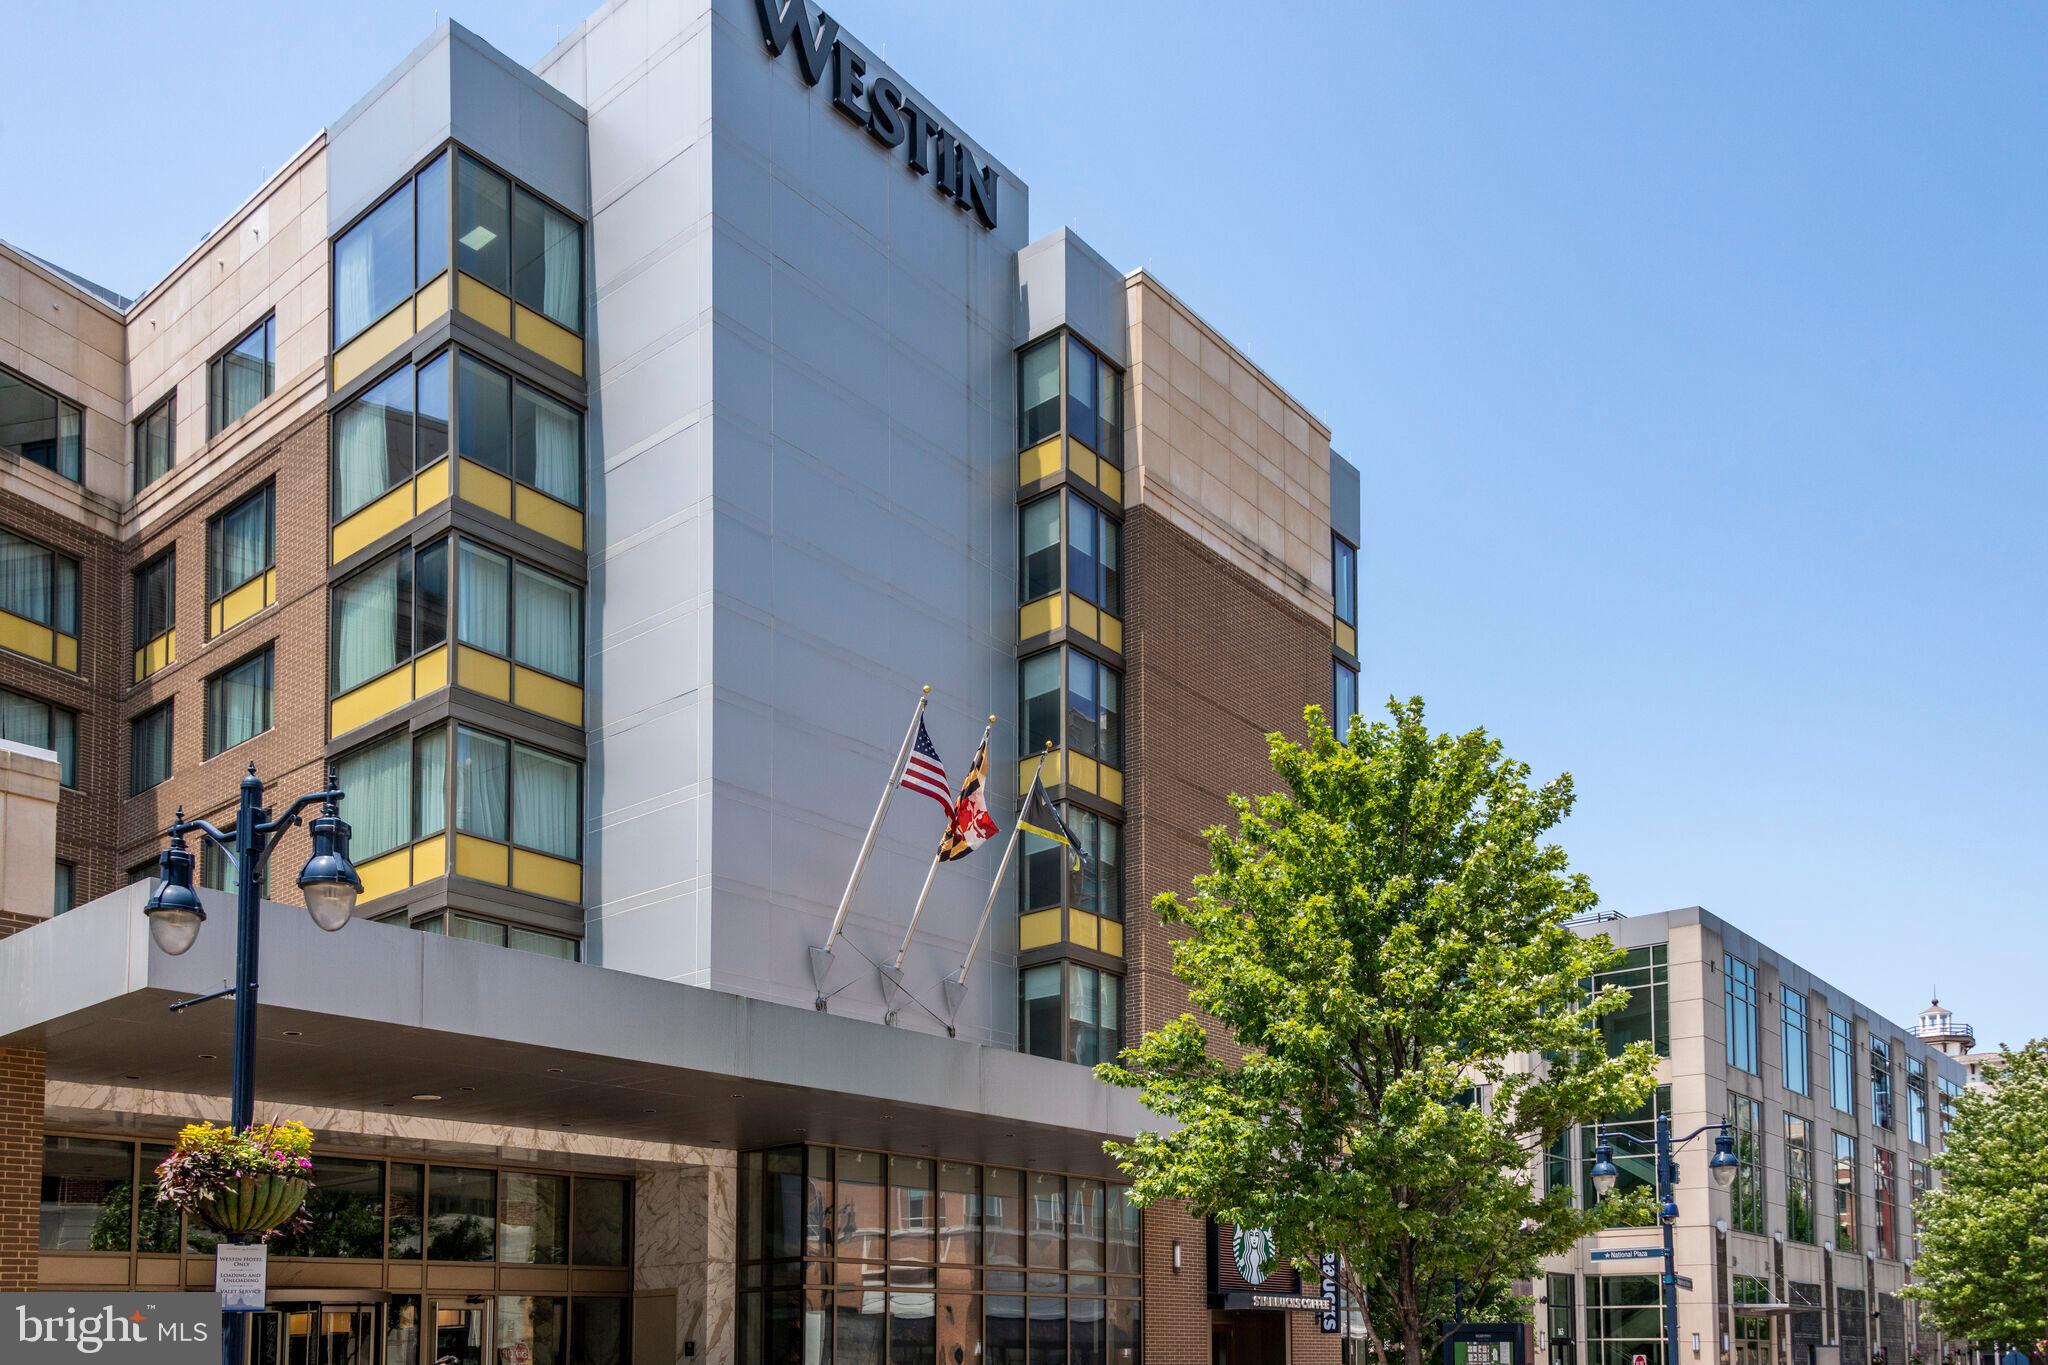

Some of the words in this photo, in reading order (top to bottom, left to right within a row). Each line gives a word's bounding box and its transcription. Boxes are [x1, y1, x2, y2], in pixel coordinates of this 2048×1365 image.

[755, 0, 997, 230] WESTIN
[1610, 1251, 1632, 1259] National
[1253, 1296, 1301, 1308] STARBUCKS
[1301, 1299, 1330, 1310] COFFEE
[1322, 1251, 1337, 1331] RBUCKS
